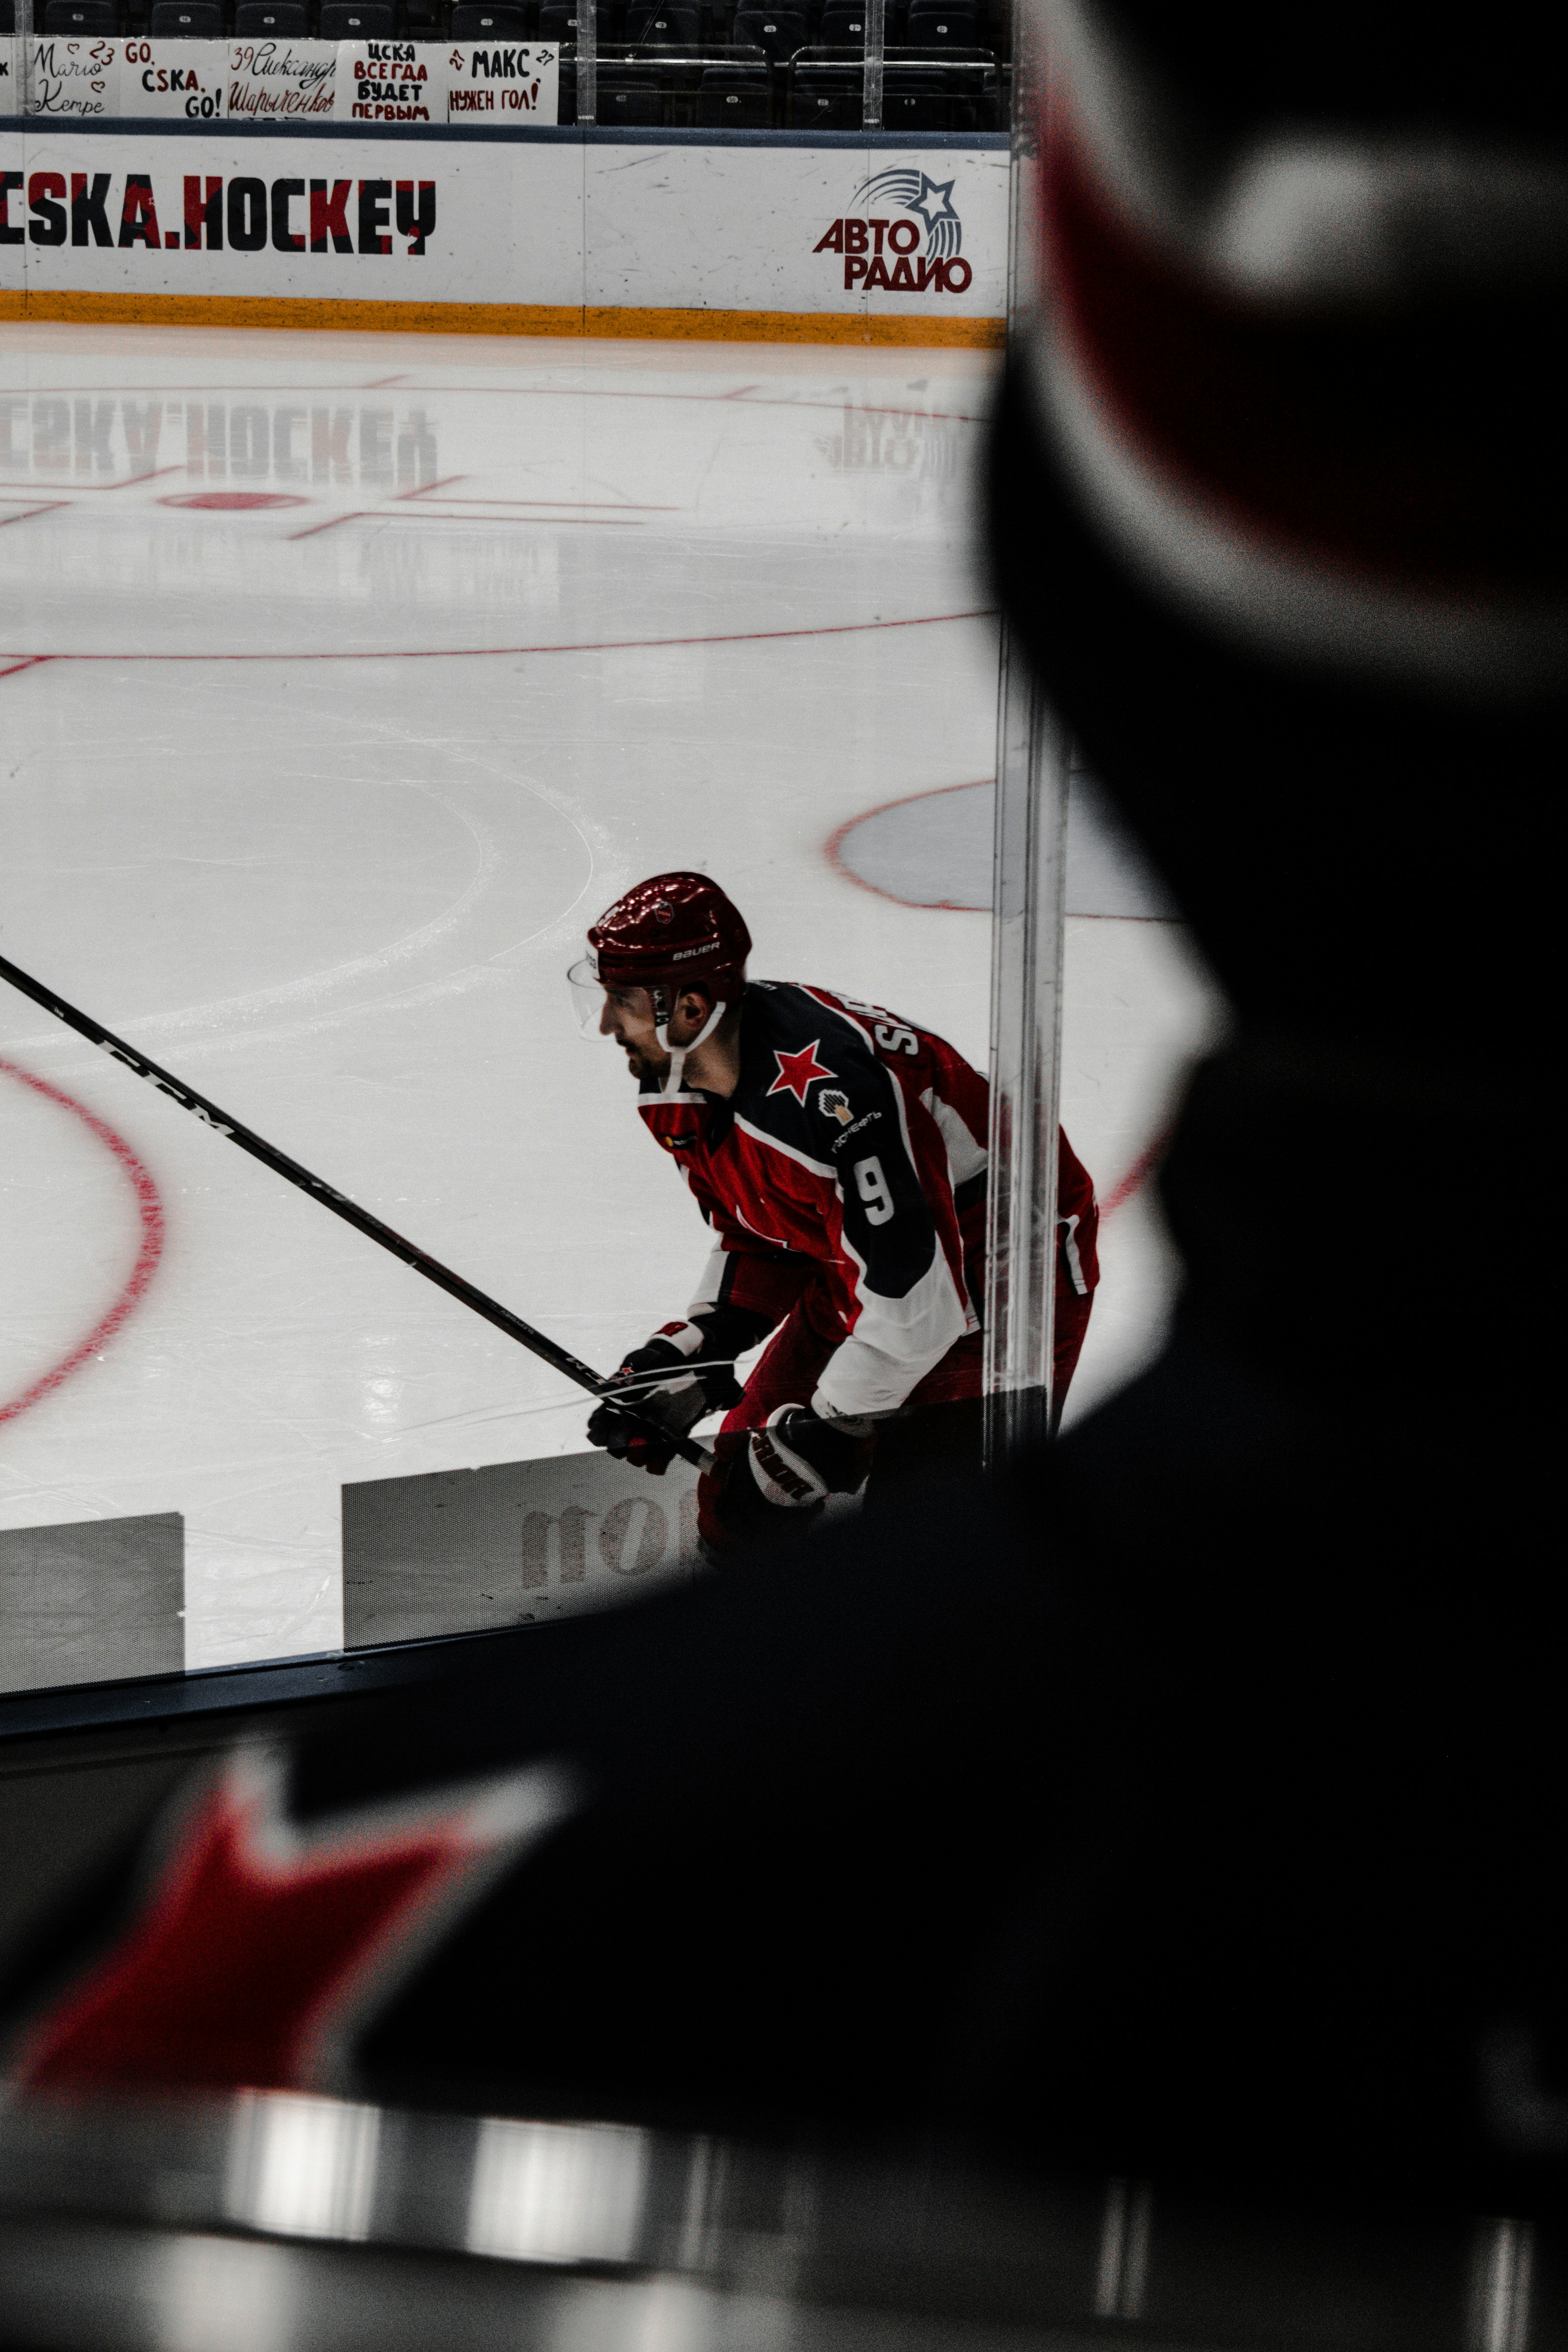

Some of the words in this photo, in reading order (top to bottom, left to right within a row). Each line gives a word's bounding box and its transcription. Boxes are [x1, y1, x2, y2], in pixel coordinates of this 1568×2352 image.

[34, 43, 102, 78] Mario
[89, 41, 115, 65] 23
[231, 46, 254, 70] 39
[368, 43, 416, 62] ЦСКА
[449, 49, 465, 70] 27
[536, 49, 554, 66] 27
[354, 61, 428, 82] ВСЕГДА
[35, 79, 105, 116] Kempe
[185, 88, 222, 118] GO!
[358, 80, 422, 101] БУДЕТ
[449, 90, 494, 111] НУЖЕН
[502, 82, 538, 110] ГОЛ!
[352, 103, 430, 121] ПЕРВЫМ
[0, 171, 436, 255] CSKA.HOCKEY
[812, 219, 920, 255] АВТО
[844, 256, 973, 293] РАДИО
[853, 1155, 895, 1226] 9
